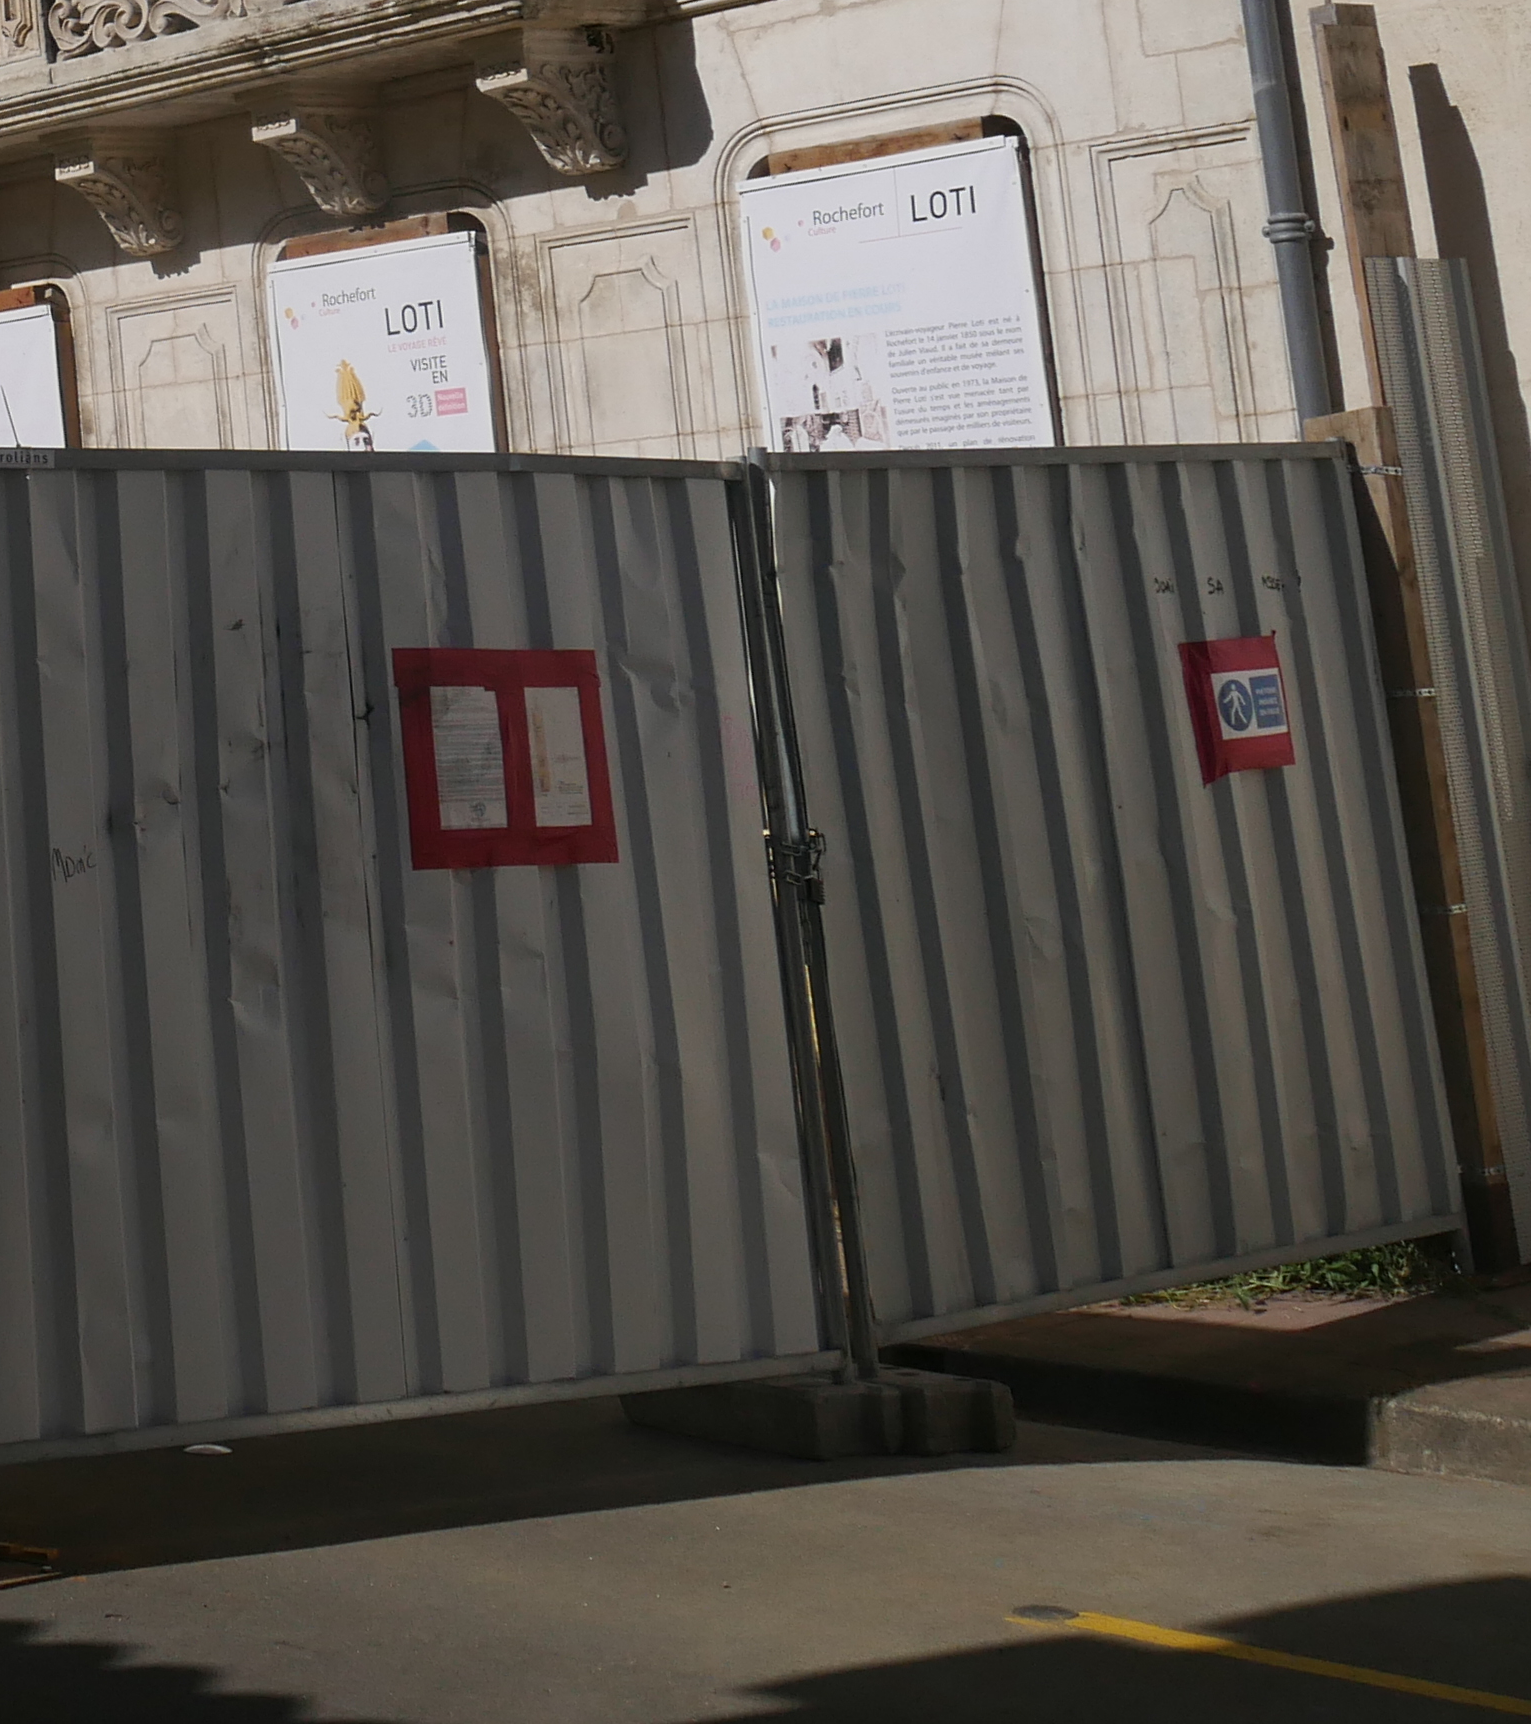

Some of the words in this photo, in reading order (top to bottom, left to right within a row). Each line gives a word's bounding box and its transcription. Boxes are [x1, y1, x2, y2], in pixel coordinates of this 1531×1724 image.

[813, 202, 884, 226] Rochefort
[910, 185, 977, 222] LOTI
[807, 226, 837, 237] Culture
[322, 287, 377, 307] Rochefort
[767, 299, 778, 310] LA
[781, 294, 823, 309] MAISON
[826, 291, 840, 303] DE
[843, 285, 879, 300] PIERRE
[881, 282, 905, 295] LOTI
[318, 308, 341, 317] Culture
[384, 299, 444, 336] LOTI
[388, 343, 396, 353] LE
[397, 338, 427, 352] VOYAGE
[410, 355, 447, 372] VISITE
[432, 370, 448, 384] EN
